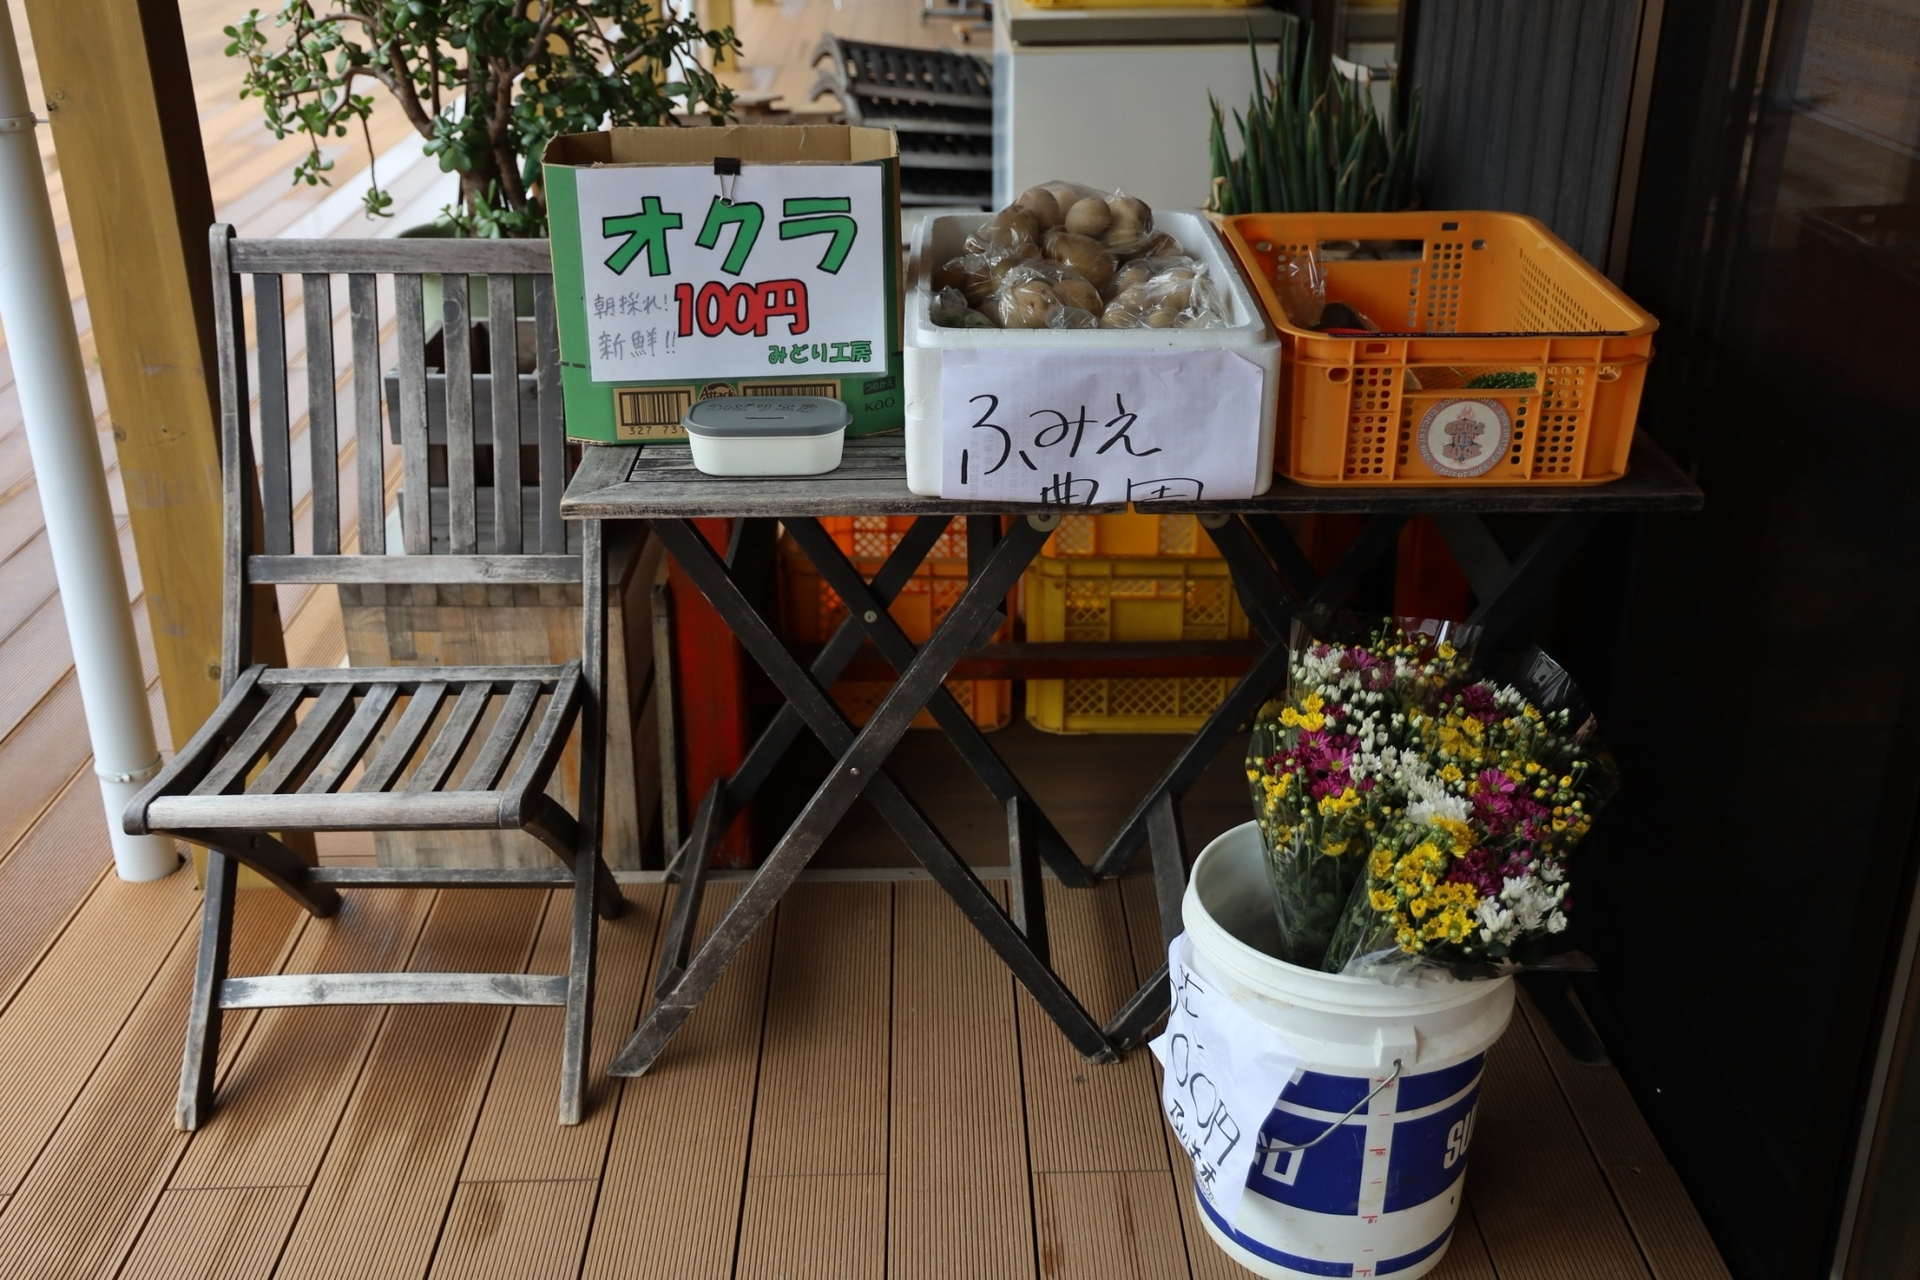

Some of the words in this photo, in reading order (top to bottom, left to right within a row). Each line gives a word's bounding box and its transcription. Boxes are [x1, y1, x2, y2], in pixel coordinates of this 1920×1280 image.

[602, 195, 859, 277] オクラ
[674, 279, 810, 337] 100円
[768, 340, 873, 365] みどり工房
[629, 426, 652, 435] 327
[961, 393, 1163, 485] ふみえ
